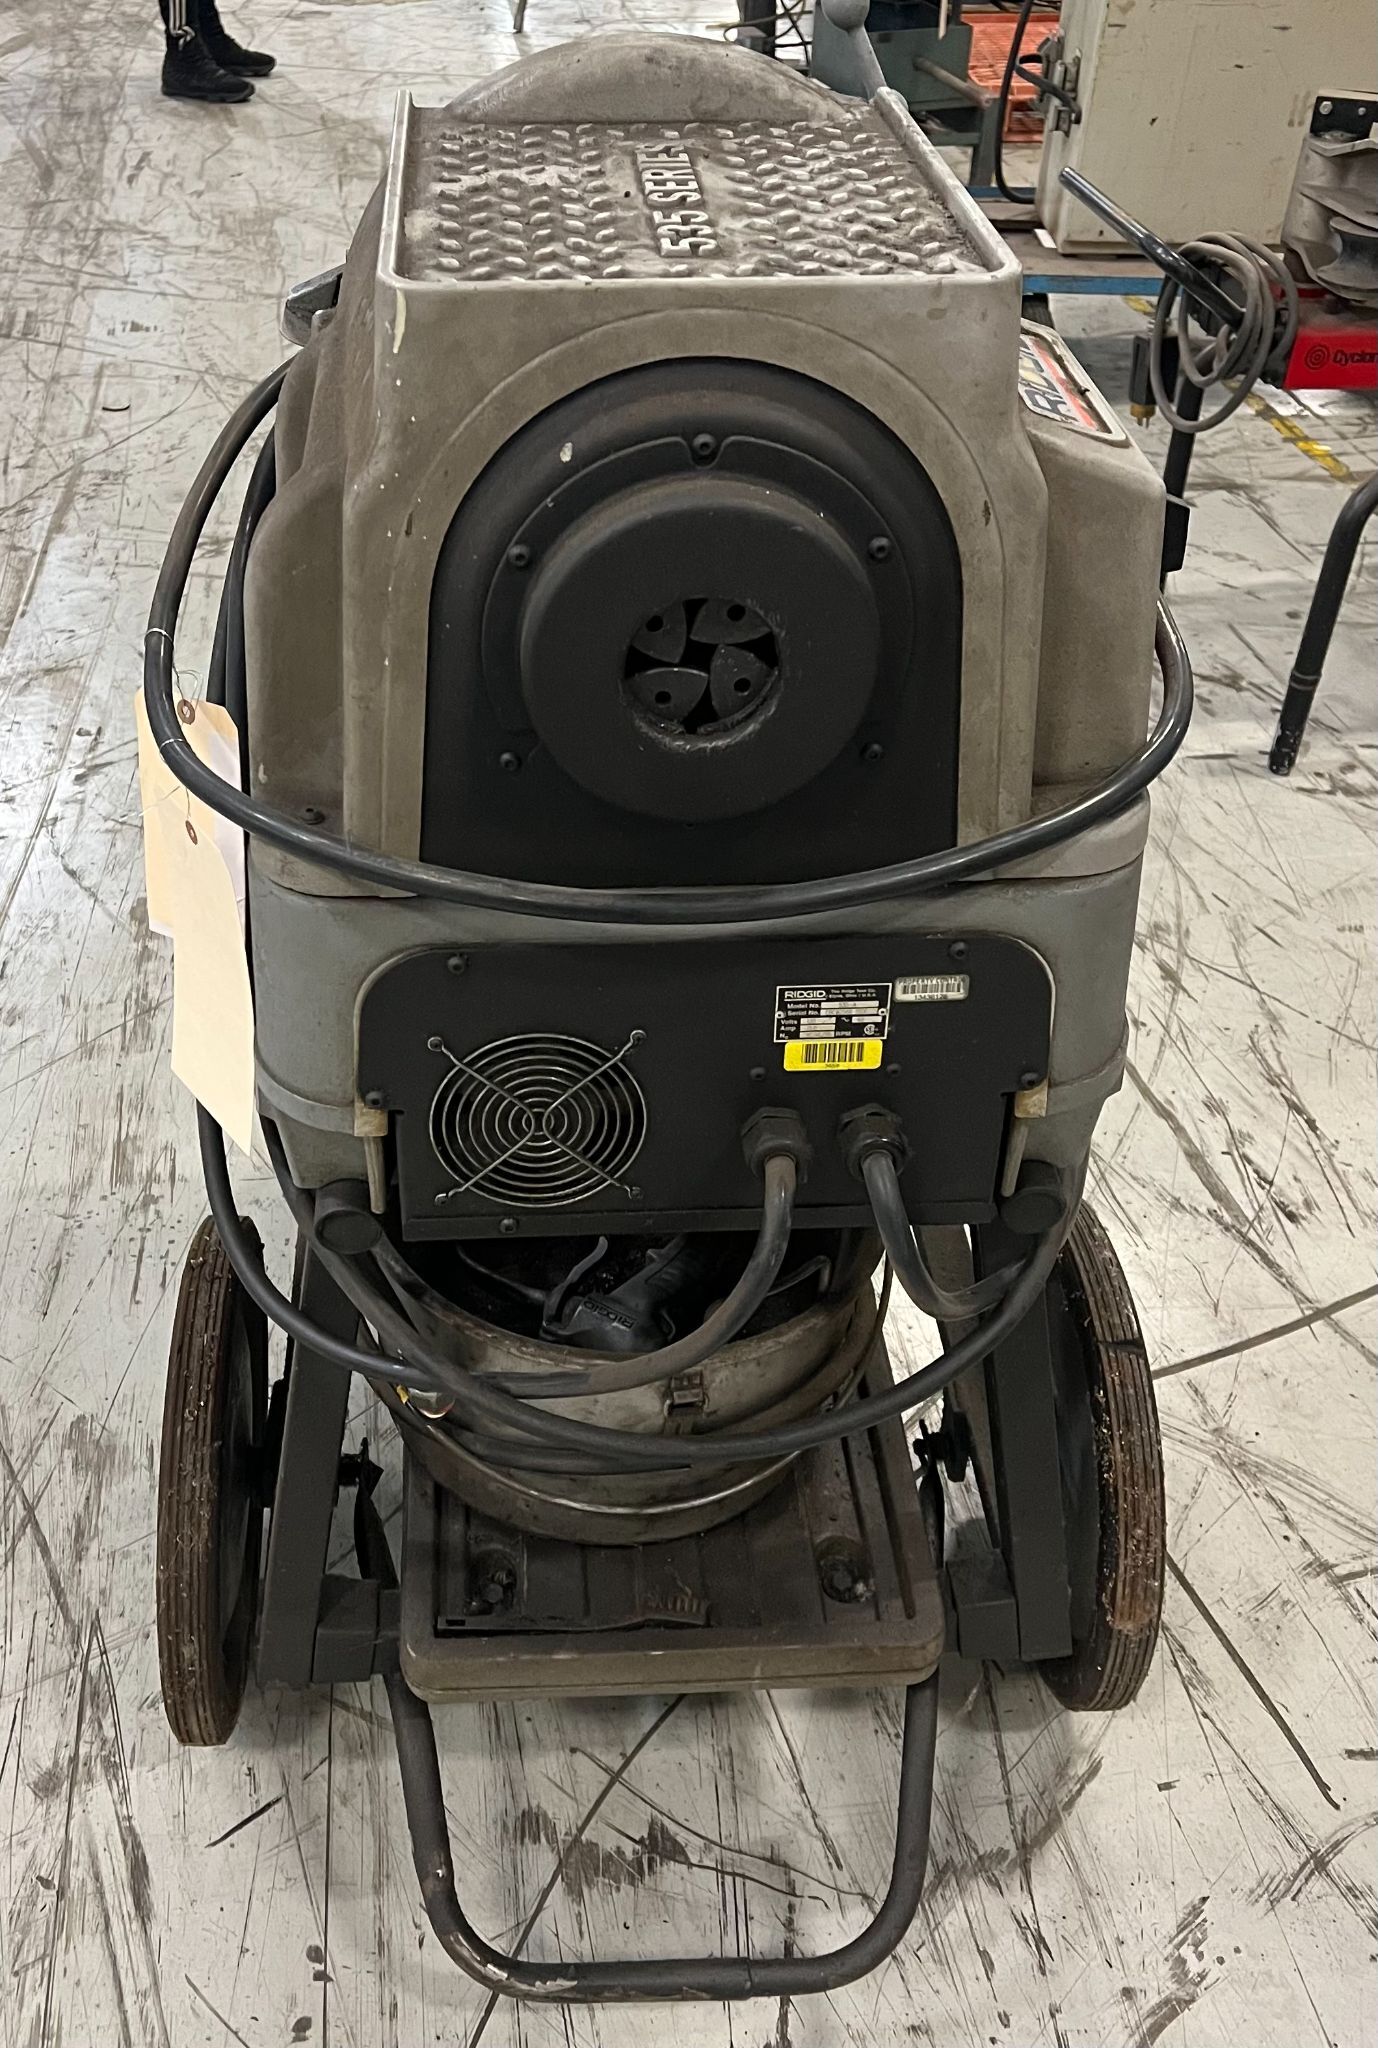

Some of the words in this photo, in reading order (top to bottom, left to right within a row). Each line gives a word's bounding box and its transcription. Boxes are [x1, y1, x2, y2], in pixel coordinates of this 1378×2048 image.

[636, 143, 701, 203] SERIES
[653, 210, 717, 256] 535
[784, 989, 826, 999] RIDGID
[583, 1300, 635, 1330] RIDGID
